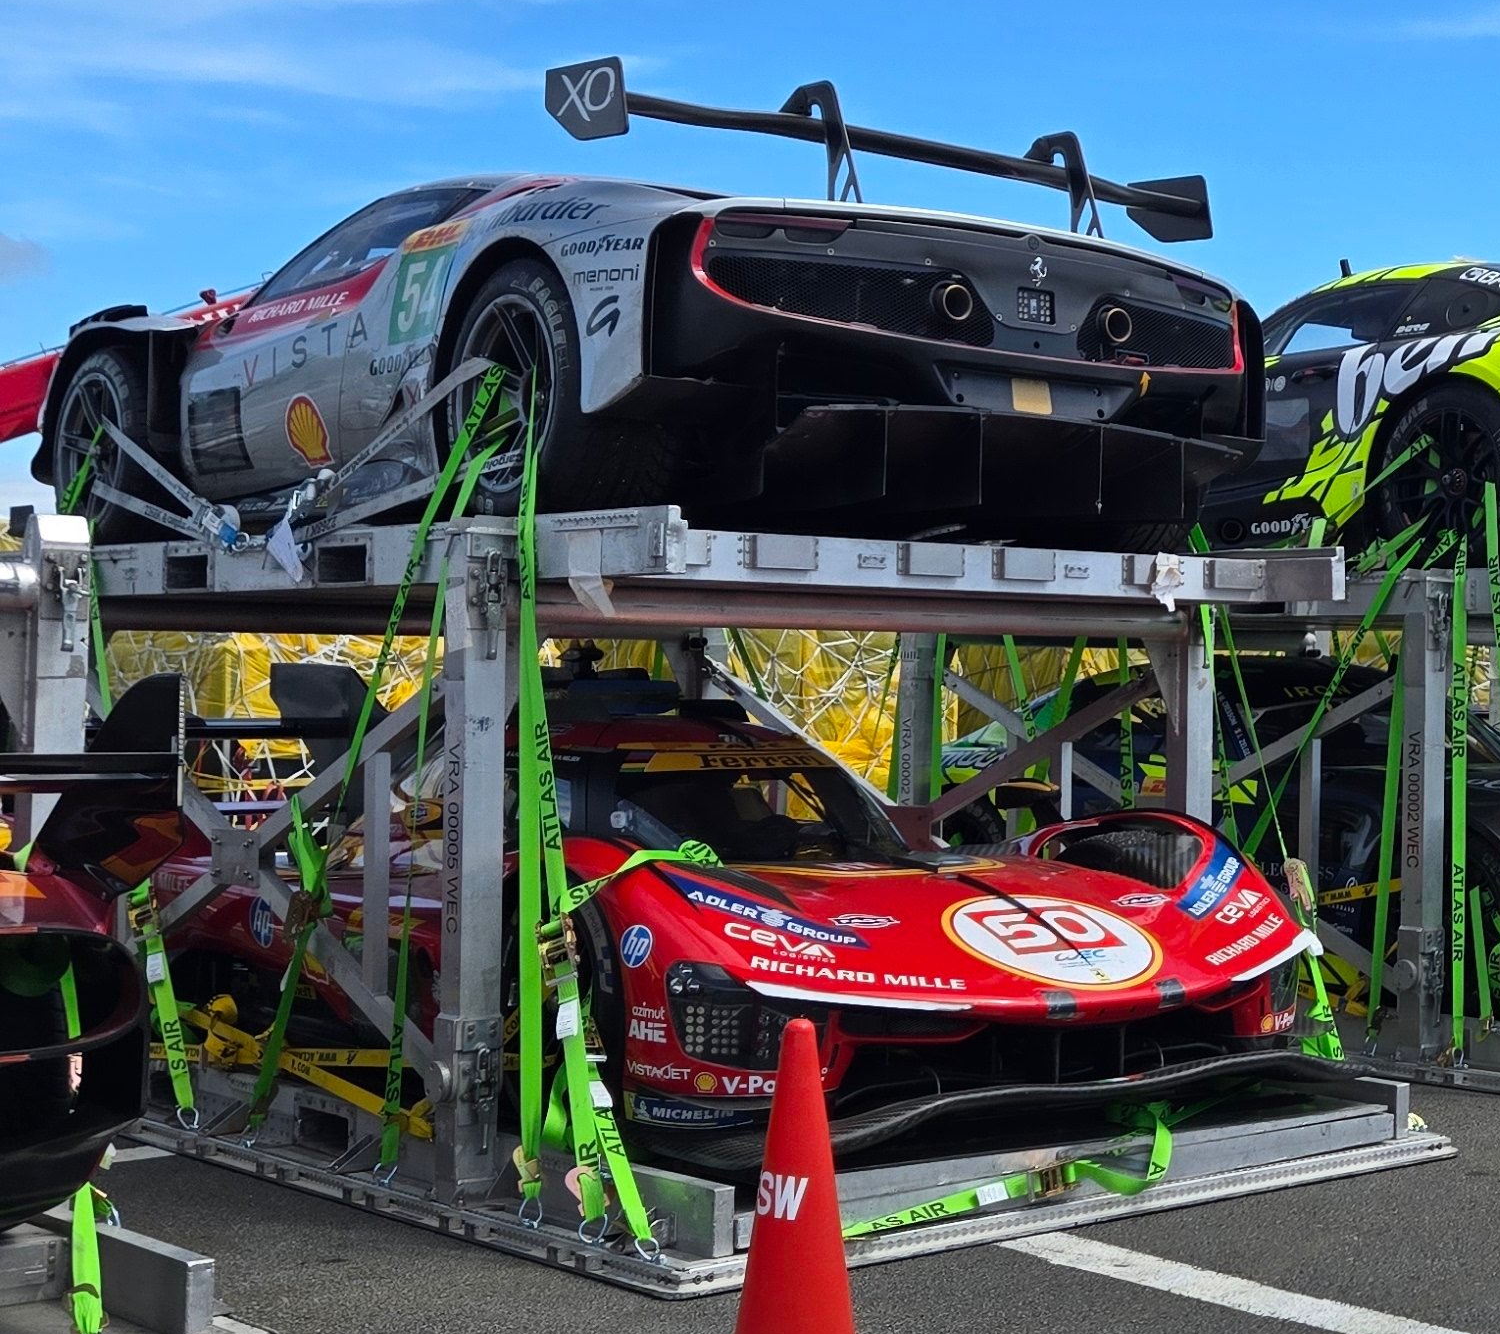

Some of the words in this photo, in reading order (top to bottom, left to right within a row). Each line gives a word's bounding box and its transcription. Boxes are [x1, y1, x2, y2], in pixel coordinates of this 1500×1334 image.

[561, 234, 645, 257] GOODYEAR
[573, 264, 640, 285] menoni
[248, 299, 305, 324] RICHARD
[305, 291, 350, 313] MILLE
[398, 255, 447, 333] 54
[243, 312, 368, 388] VISTA
[465, 364, 506, 438] ATLAS
[1409, 434, 1434, 459] ATL
[1251, 513, 1316, 535] GOODY
[399, 557, 418, 595] AIR
[1489, 554, 1500, 587] AIR
[1323, 654, 1352, 702] ATLAS
[1350, 625, 1369, 656] AIR
[1019, 697, 1034, 723] AIR
[1453, 662, 1465, 723] ATLAS
[534, 719, 552, 765] AIR
[901, 717, 912, 749] VRA
[1407, 730, 1422, 769] VRA
[1452, 725, 1465, 759] AIR
[448, 744, 460, 795] VRA
[699, 751, 821, 769] Ferrari
[900, 752, 911, 795] 00002
[1120, 726, 1133, 793] ATLAS
[538, 770, 562, 851] ATLAS
[1406, 773, 1421, 822] 00002
[446, 800, 460, 871] 00005
[1406, 827, 1420, 869] WEC
[446, 875, 459, 934] WEC
[1452, 863, 1466, 931] ATLAS
[687, 890, 758, 919] ADLER
[786, 921, 857, 946] GROUP
[981, 910, 1107, 950] 50
[623, 927, 650, 965] hp
[773, 948, 837, 964] LOGISTICS
[1054, 948, 1107, 963] WEC
[1204, 931, 1255, 967] RICHARD
[1251, 913, 1285, 945] MILLE
[1452, 932, 1465, 963] AIR
[751, 955, 876, 984] RICHARD
[884, 973, 967, 990] MILLE
[631, 1001, 666, 1021] azimut
[162, 1017, 184, 1054] AIR
[628, 1020, 668, 1044] AHE
[384, 1023, 405, 1103] ATLAS
[626, 1059, 691, 1081] VISTAJET
[722, 1075, 777, 1095] V-Po
[592, 1105, 627, 1158] ATLA
[652, 1107, 735, 1120] MICHELIN
[908, 1201, 950, 1224] AIR
